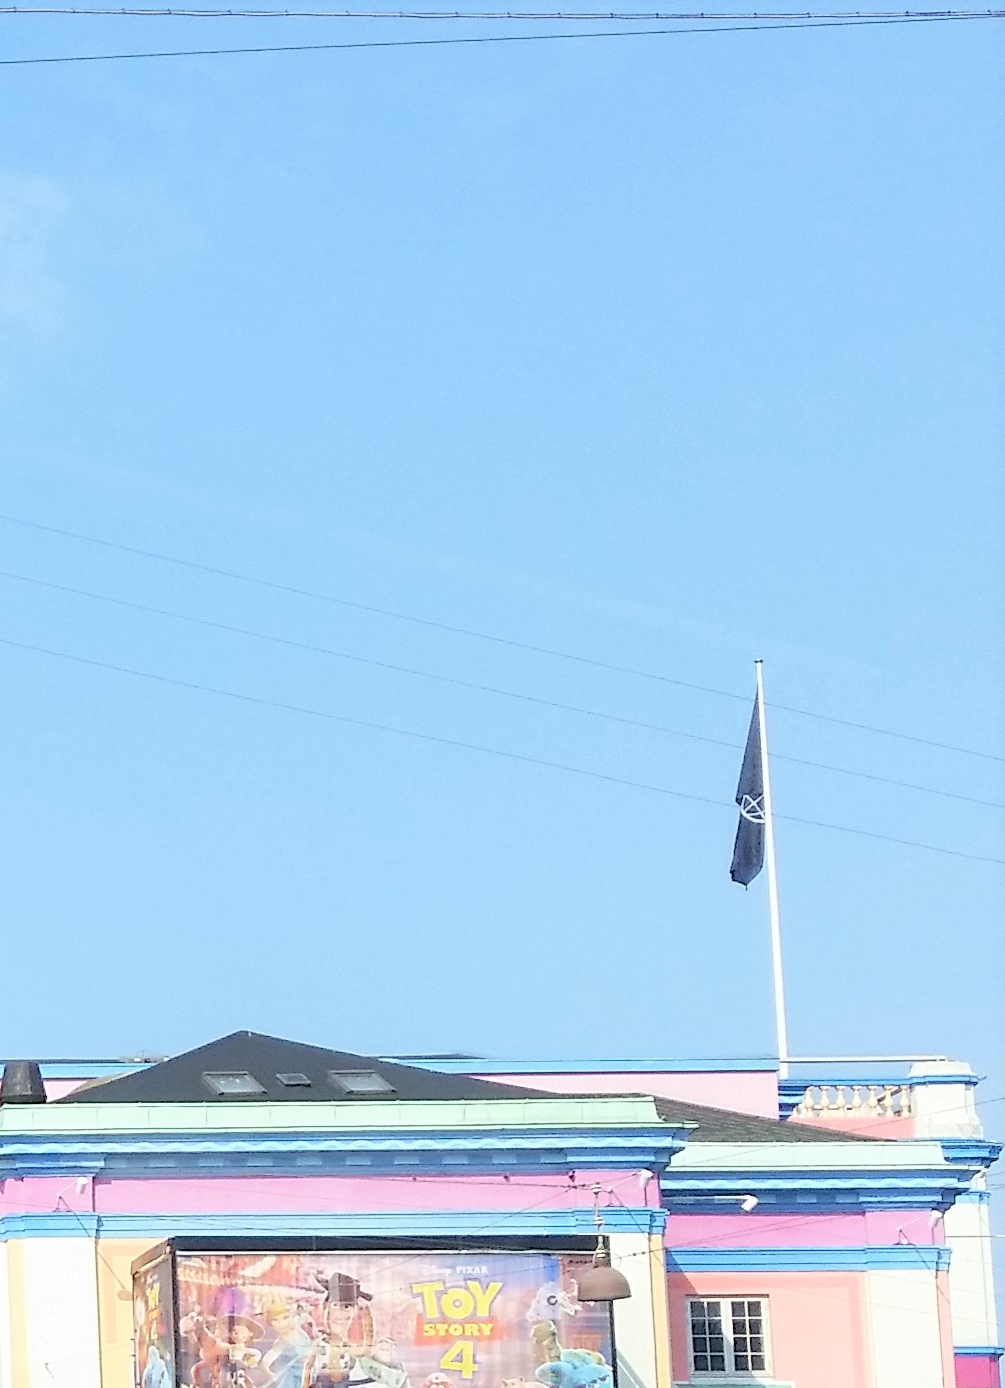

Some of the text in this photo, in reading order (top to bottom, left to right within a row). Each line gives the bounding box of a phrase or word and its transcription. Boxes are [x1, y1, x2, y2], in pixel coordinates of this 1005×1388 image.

[455, 1266, 489, 1274] PIXAR
[411, 1280, 503, 1320] TOY
[423, 1323, 494, 1336] STORY
[440, 1340, 479, 1379] 4
